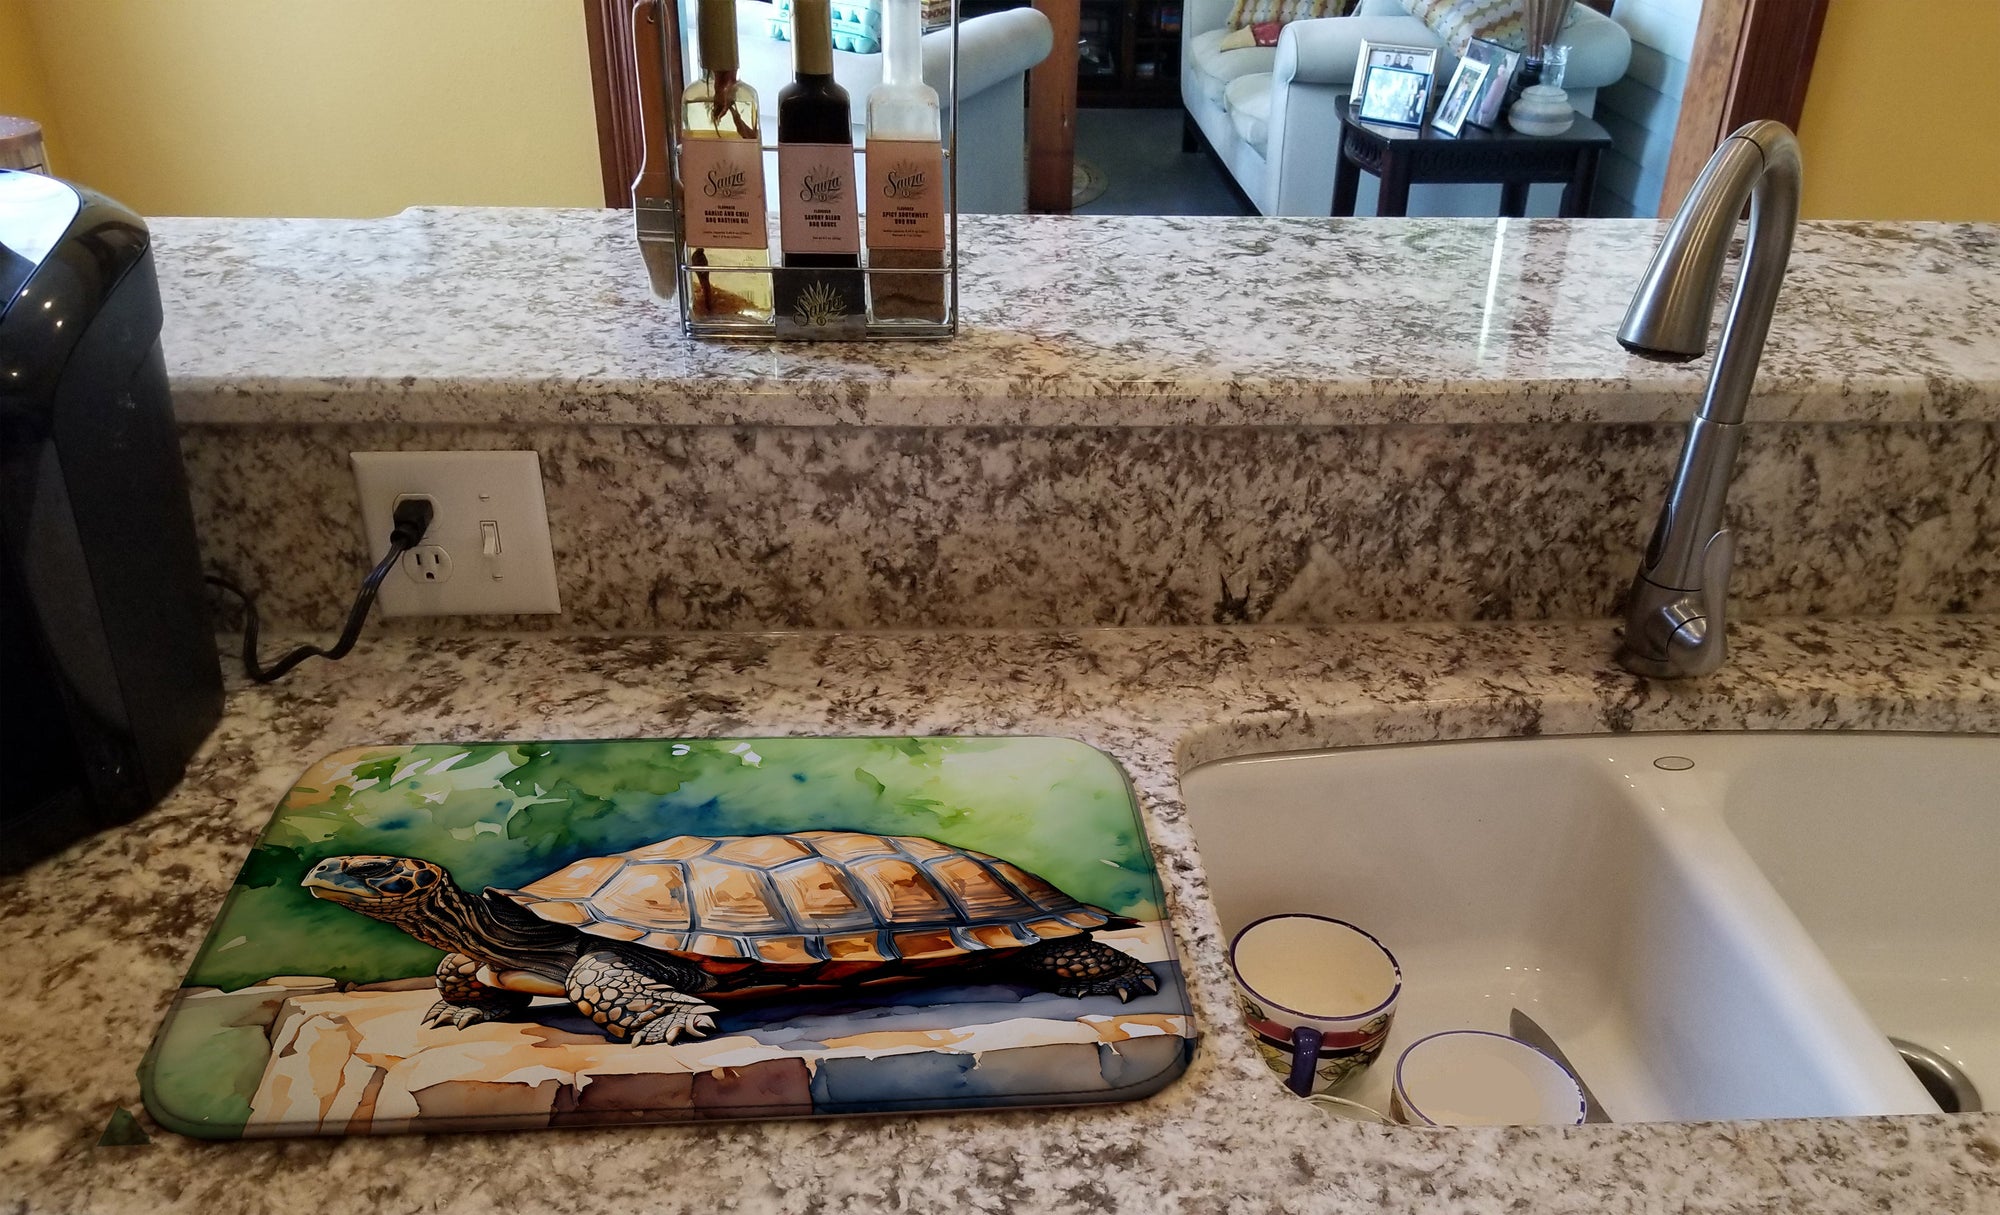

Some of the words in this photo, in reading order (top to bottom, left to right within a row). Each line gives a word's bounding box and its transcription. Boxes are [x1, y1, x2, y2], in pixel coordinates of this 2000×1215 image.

[704, 170, 745, 197] Sauza
[800, 175, 841, 202] Sauza
[884, 171, 925, 198] Sauza
